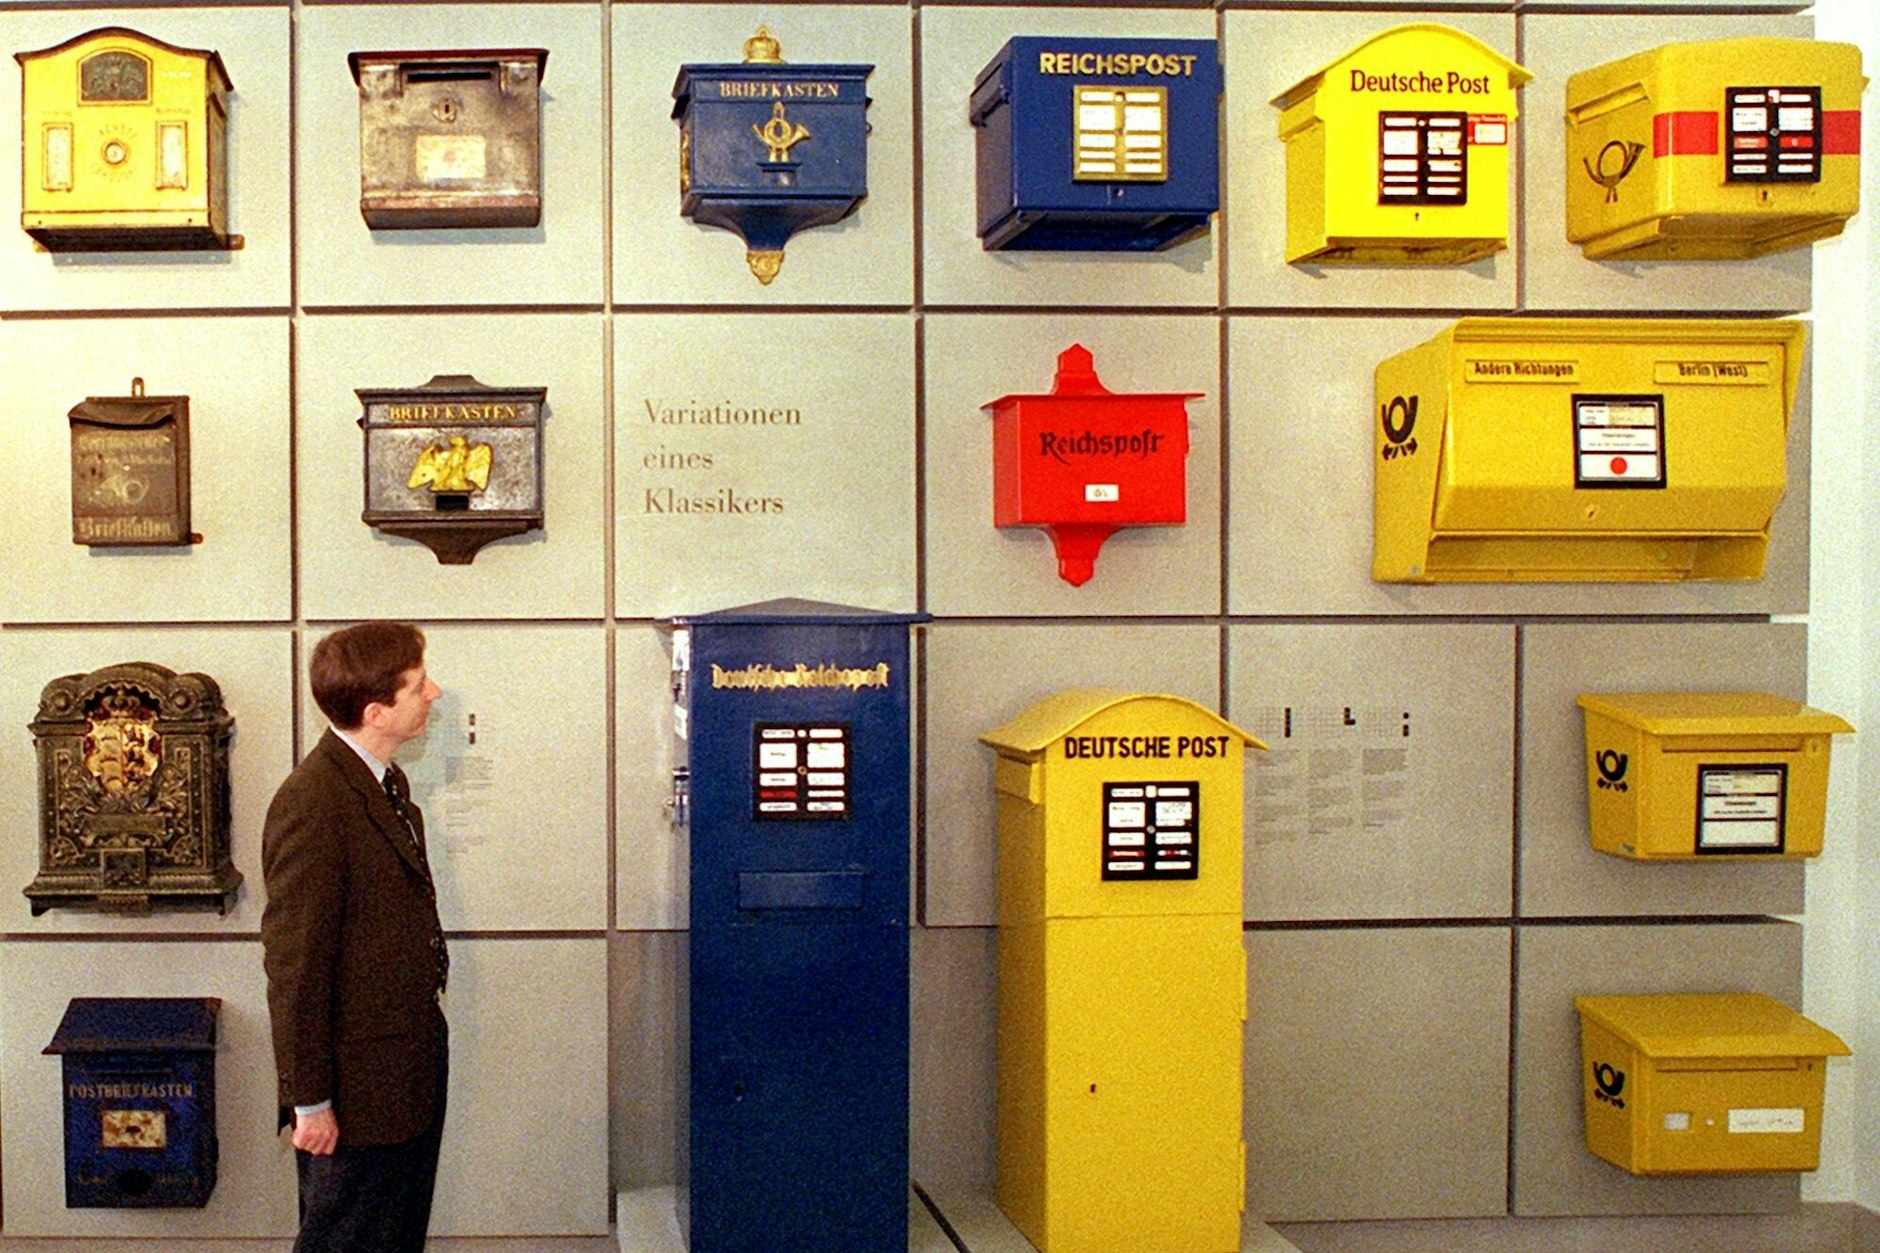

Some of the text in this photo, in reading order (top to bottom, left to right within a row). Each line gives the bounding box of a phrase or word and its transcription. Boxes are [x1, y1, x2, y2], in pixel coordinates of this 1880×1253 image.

[1040, 52, 1197, 77] REICHSPOST
[719, 82, 839, 98] BRIEFKASTEN
[1350, 70, 1490, 95] Deutsche Post
[1475, 361, 1574, 377] Andere Richtungen
[1678, 363, 1749, 379] Berlin (West)
[389, 404, 518, 421] BRIEFKASTEN
[643, 398, 801, 426] Variationen
[643, 444, 715, 470] eines
[643, 487, 784, 514] Klassikers
[1065, 735, 1230, 759] DEUTSCHE POST
